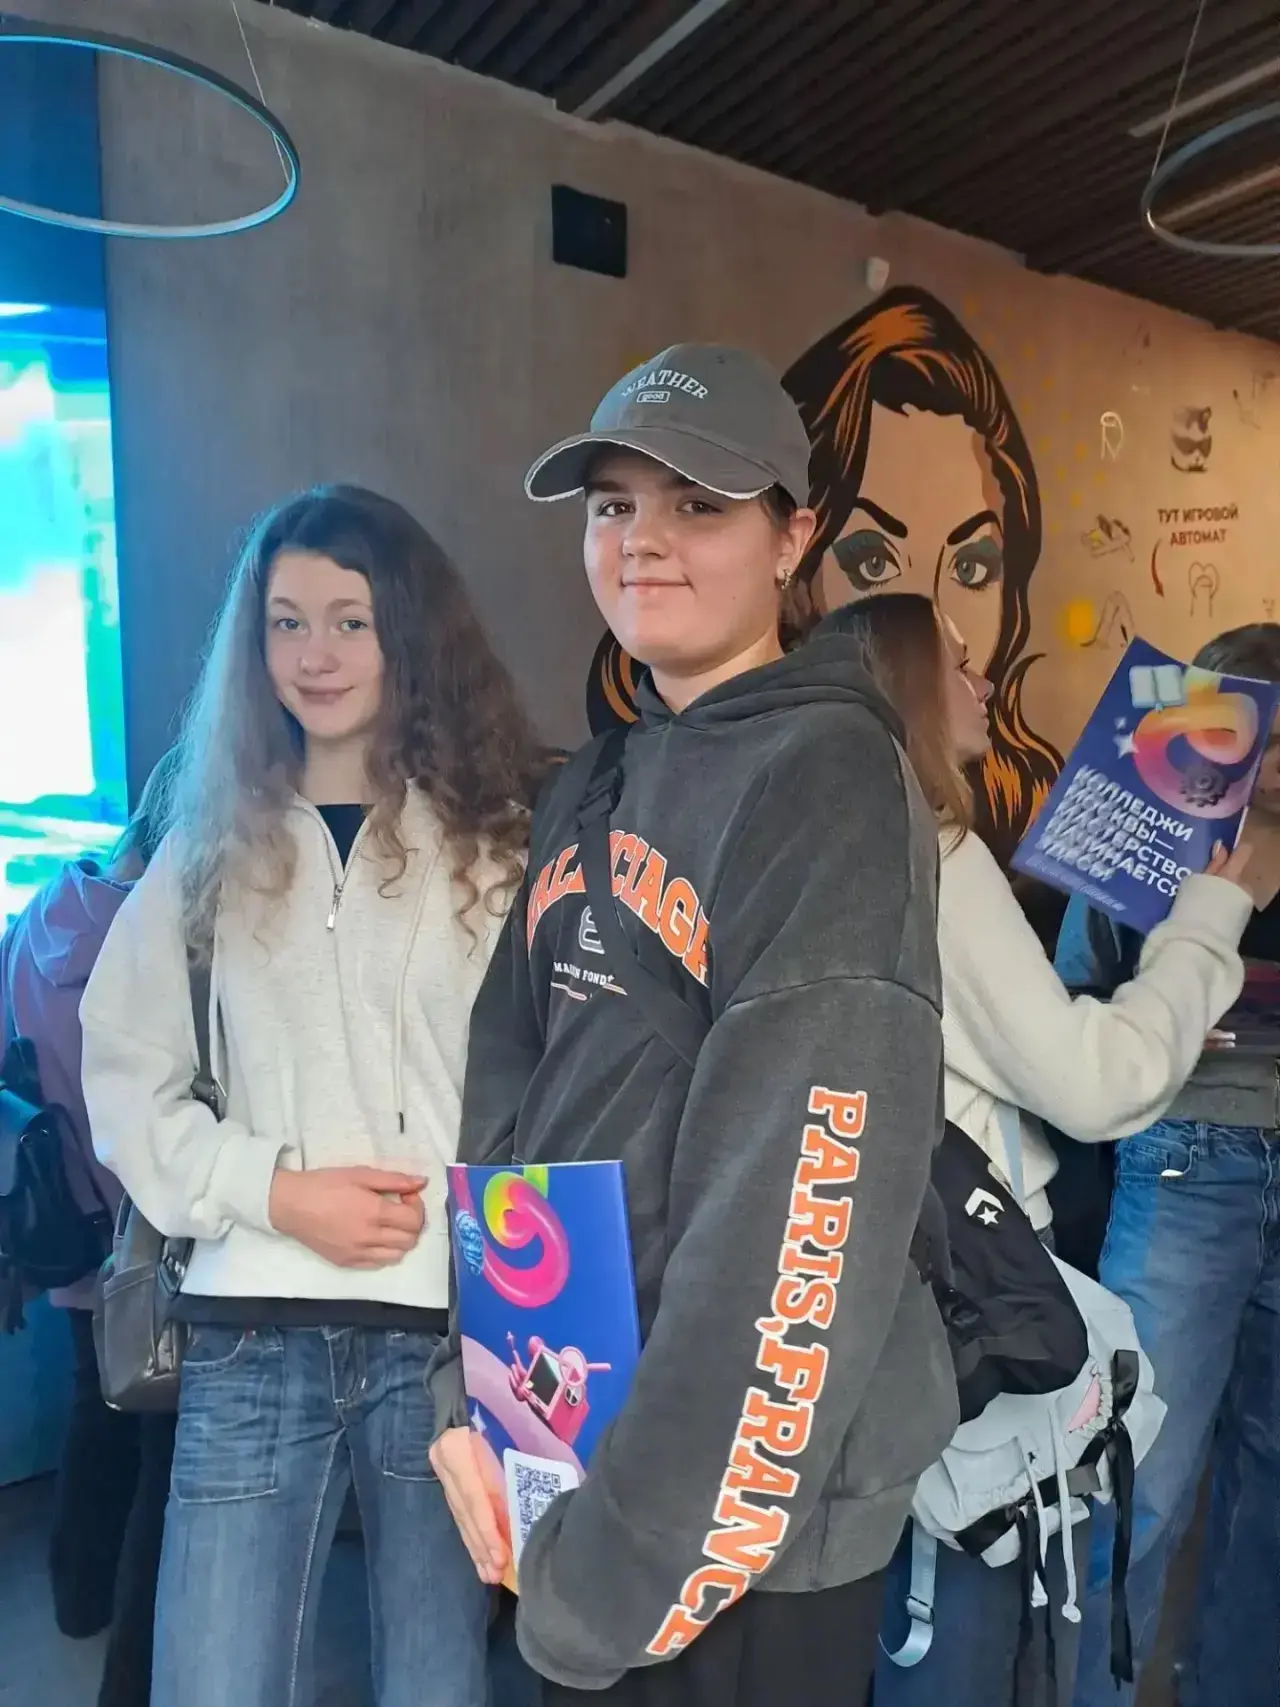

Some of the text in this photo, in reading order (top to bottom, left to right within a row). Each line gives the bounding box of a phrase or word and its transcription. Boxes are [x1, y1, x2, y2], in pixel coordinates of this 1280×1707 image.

[1157, 501, 1239, 524] ТУТ ИГРОВОЙ
[1170, 528, 1227, 547] АВТОМАТ
[1068, 764, 1194, 842] КОЛЛЕДЖИ
